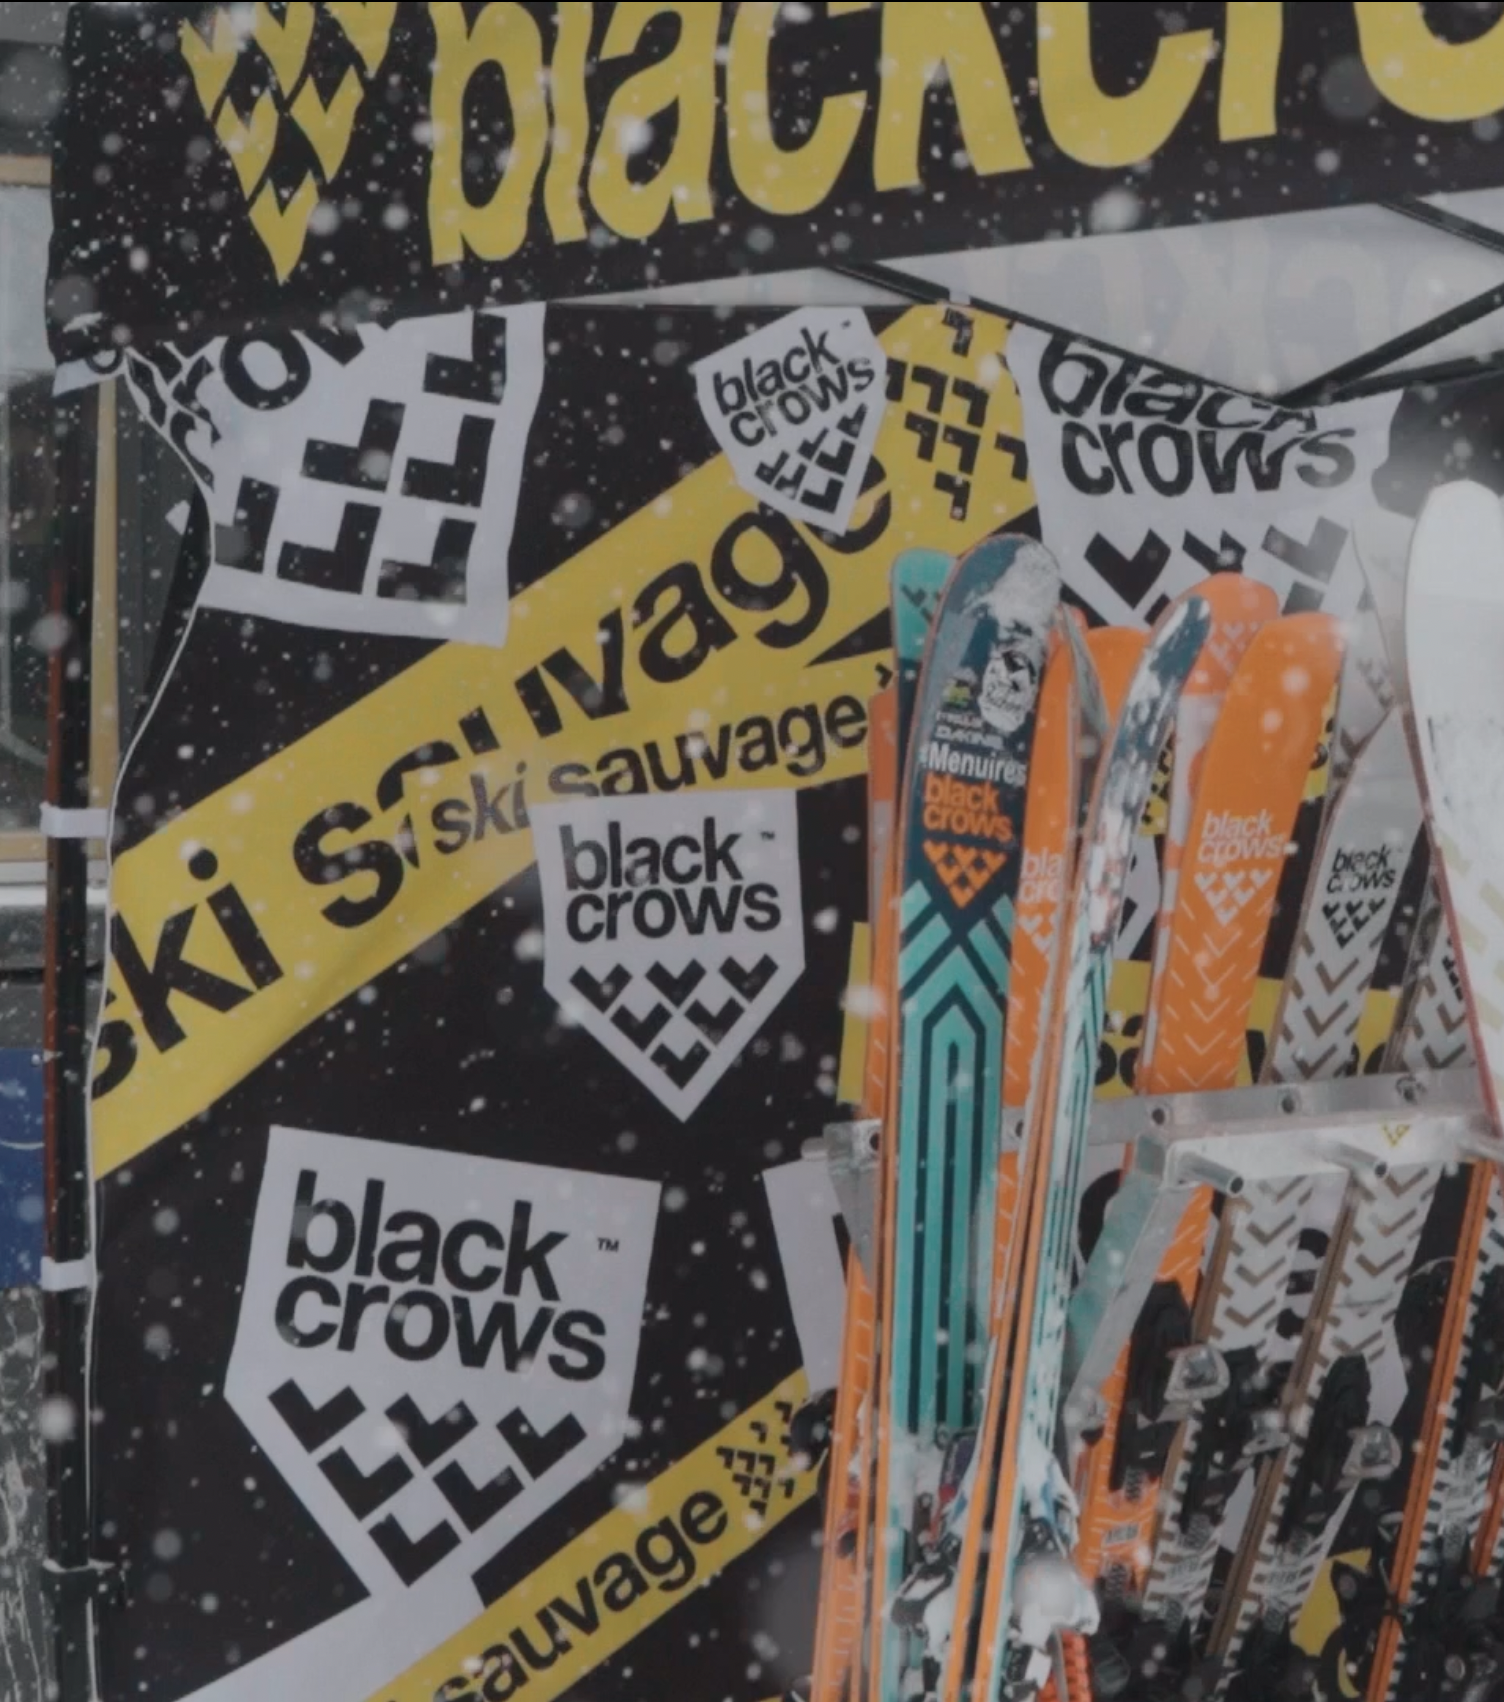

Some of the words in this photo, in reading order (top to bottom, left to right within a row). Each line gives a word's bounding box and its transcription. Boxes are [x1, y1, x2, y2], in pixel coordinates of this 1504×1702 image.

[712, 326, 841, 417] black
[729, 356, 876, 448] crows
[1061, 420, 1357, 498] crows
[431, 761, 530, 855] ski
[548, 694, 869, 798] sauvage
[925, 771, 1000, 812] black
[928, 741, 1027, 789] Menuires
[923, 804, 1014, 842] crows
[1197, 832, 1285, 863] crows
[1201, 808, 1273, 840] black
[559, 816, 744, 891] black
[1020, 846, 1064, 880] bla
[1326, 868, 1396, 894] cows
[565, 881, 782, 943] crows
[1018, 877, 1063, 903] cro
[286, 1168, 570, 1302] black
[274, 1275, 606, 1382] crows
